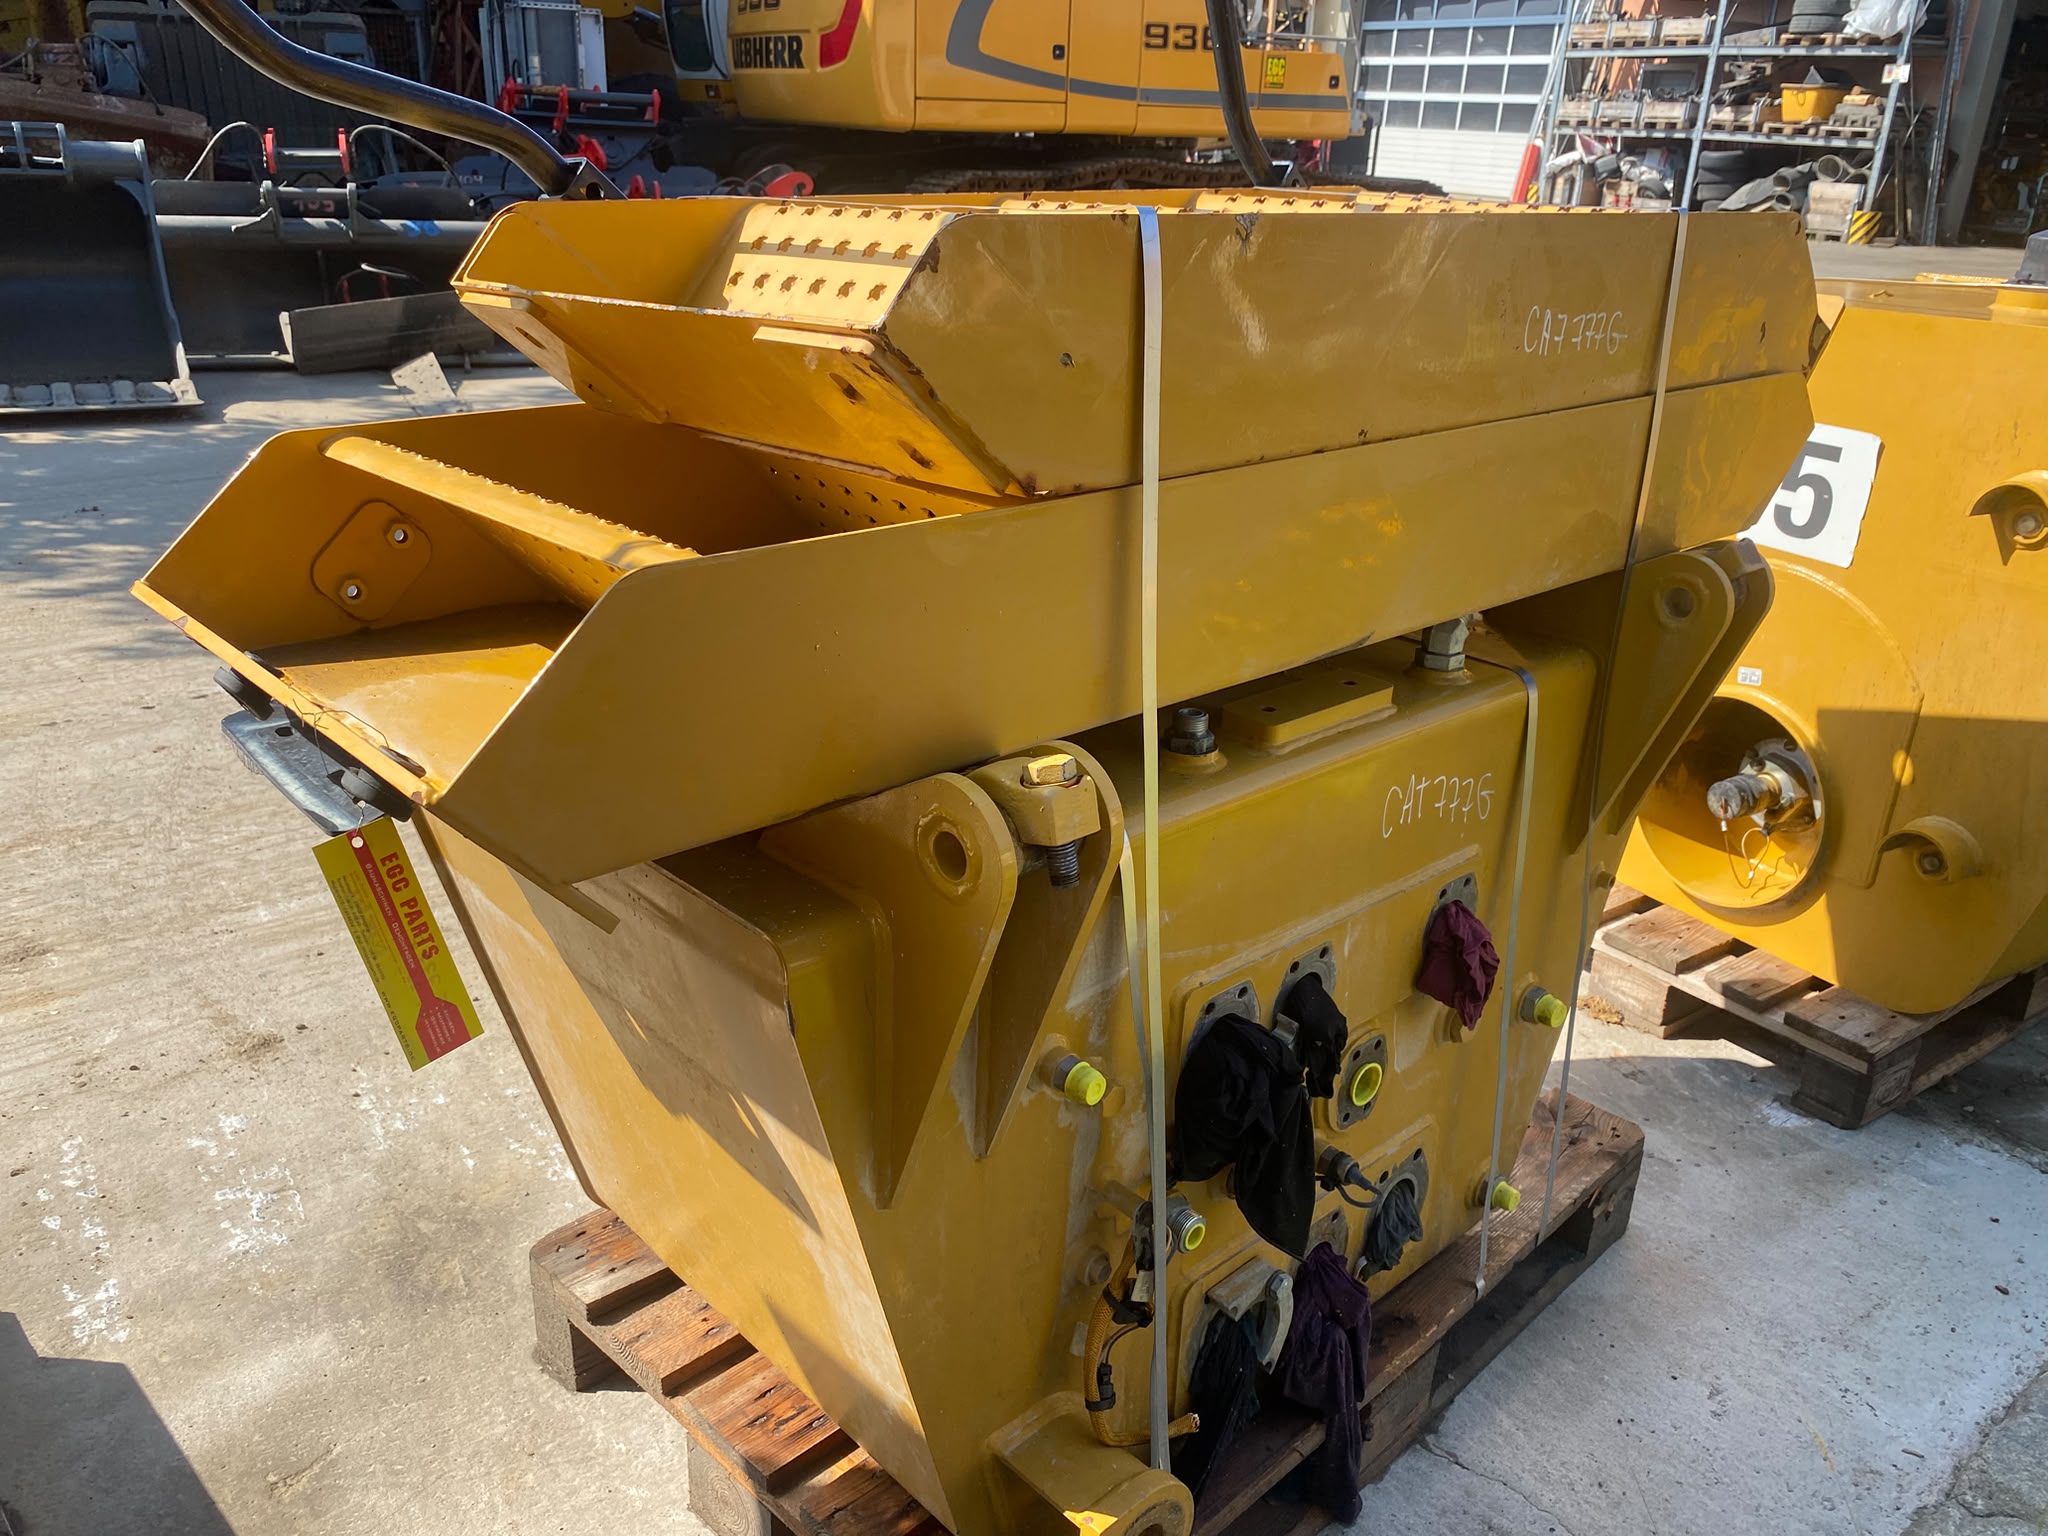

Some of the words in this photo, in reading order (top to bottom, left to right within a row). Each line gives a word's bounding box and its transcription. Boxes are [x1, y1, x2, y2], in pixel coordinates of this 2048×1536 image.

[1267, 58, 1285, 75] EGC
[1773, 441, 1843, 539] 5
[379, 851, 410, 894] EGC
[400, 897, 440, 961] PARTS
